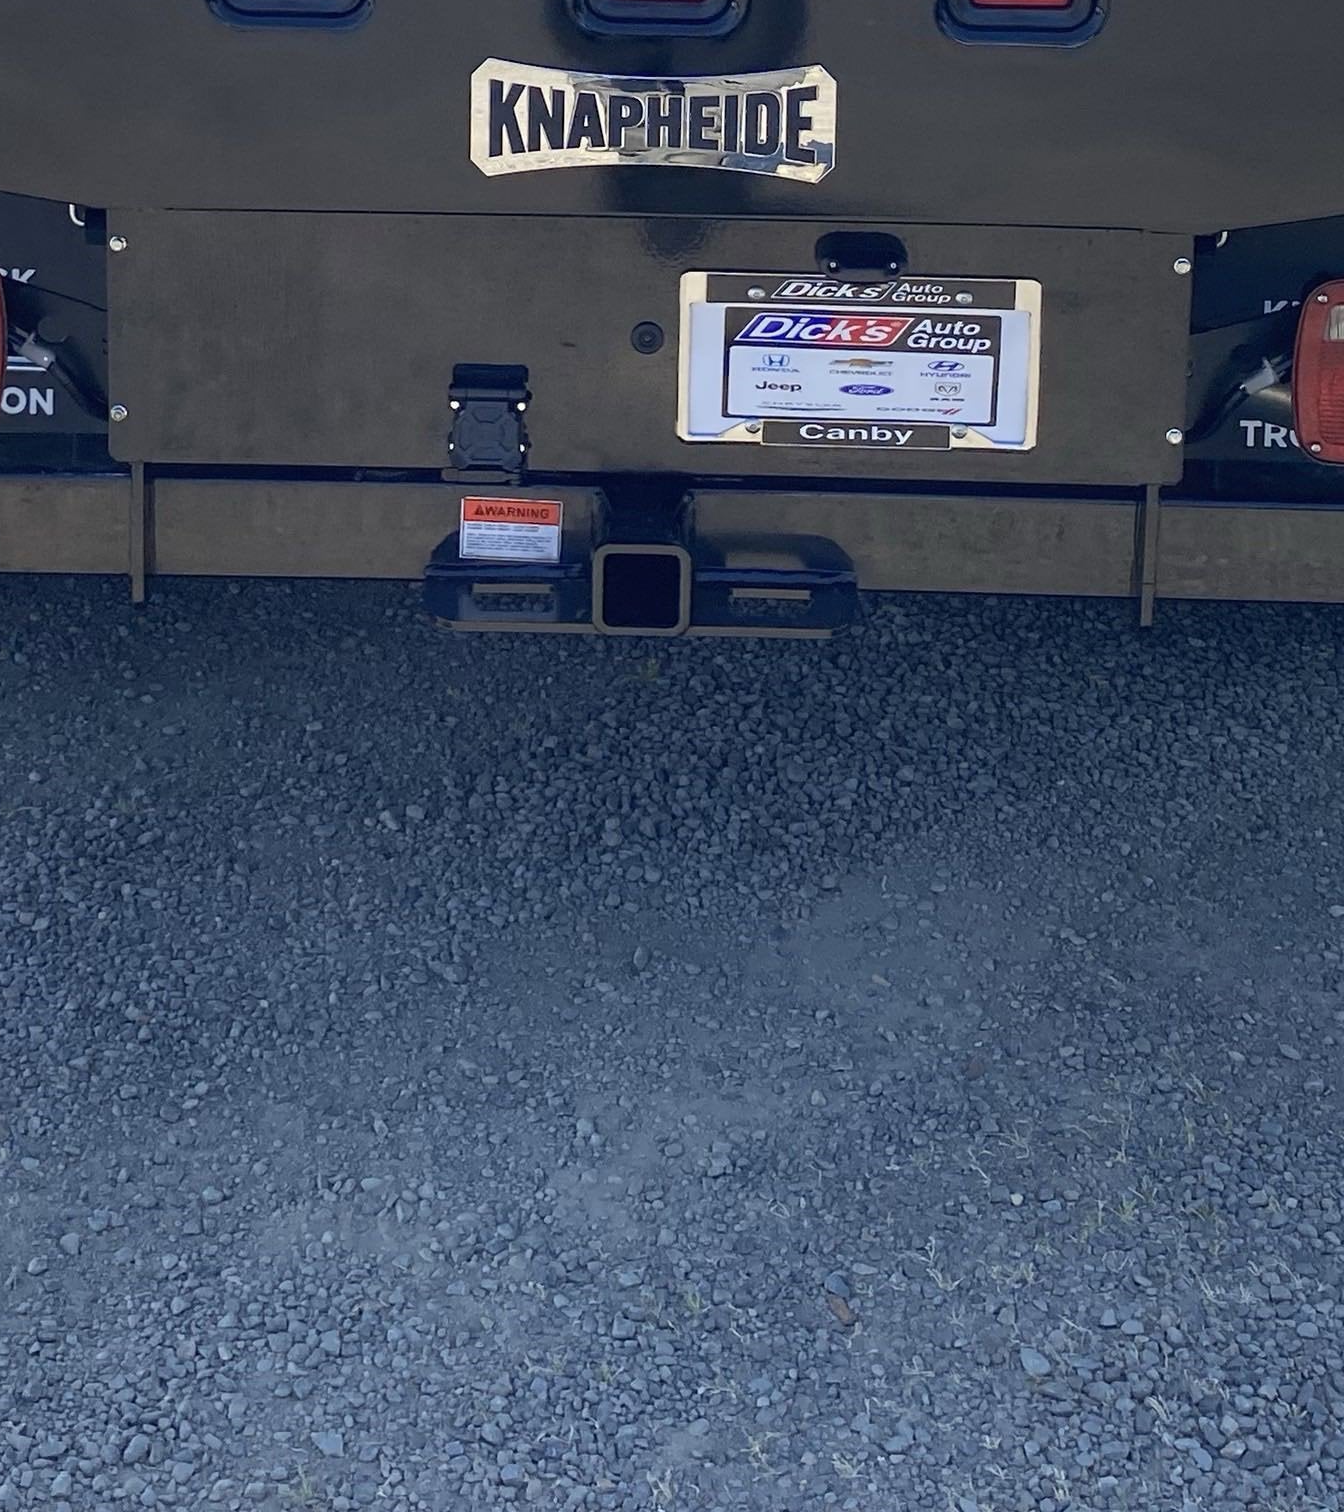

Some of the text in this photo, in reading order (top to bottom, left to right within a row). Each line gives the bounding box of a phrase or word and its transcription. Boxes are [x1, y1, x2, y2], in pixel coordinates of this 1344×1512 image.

[488, 78, 818, 165] KNAPHEIDE
[891, 291, 952, 305] Group
[896, 282, 944, 294] Auto
[749, 314, 894, 343] Dick's
[912, 318, 981, 338] Auto
[907, 333, 991, 355] Group
[754, 380, 802, 393] Jeep
[798, 423, 915, 445] Canby
[485, 505, 550, 520] WARNING
